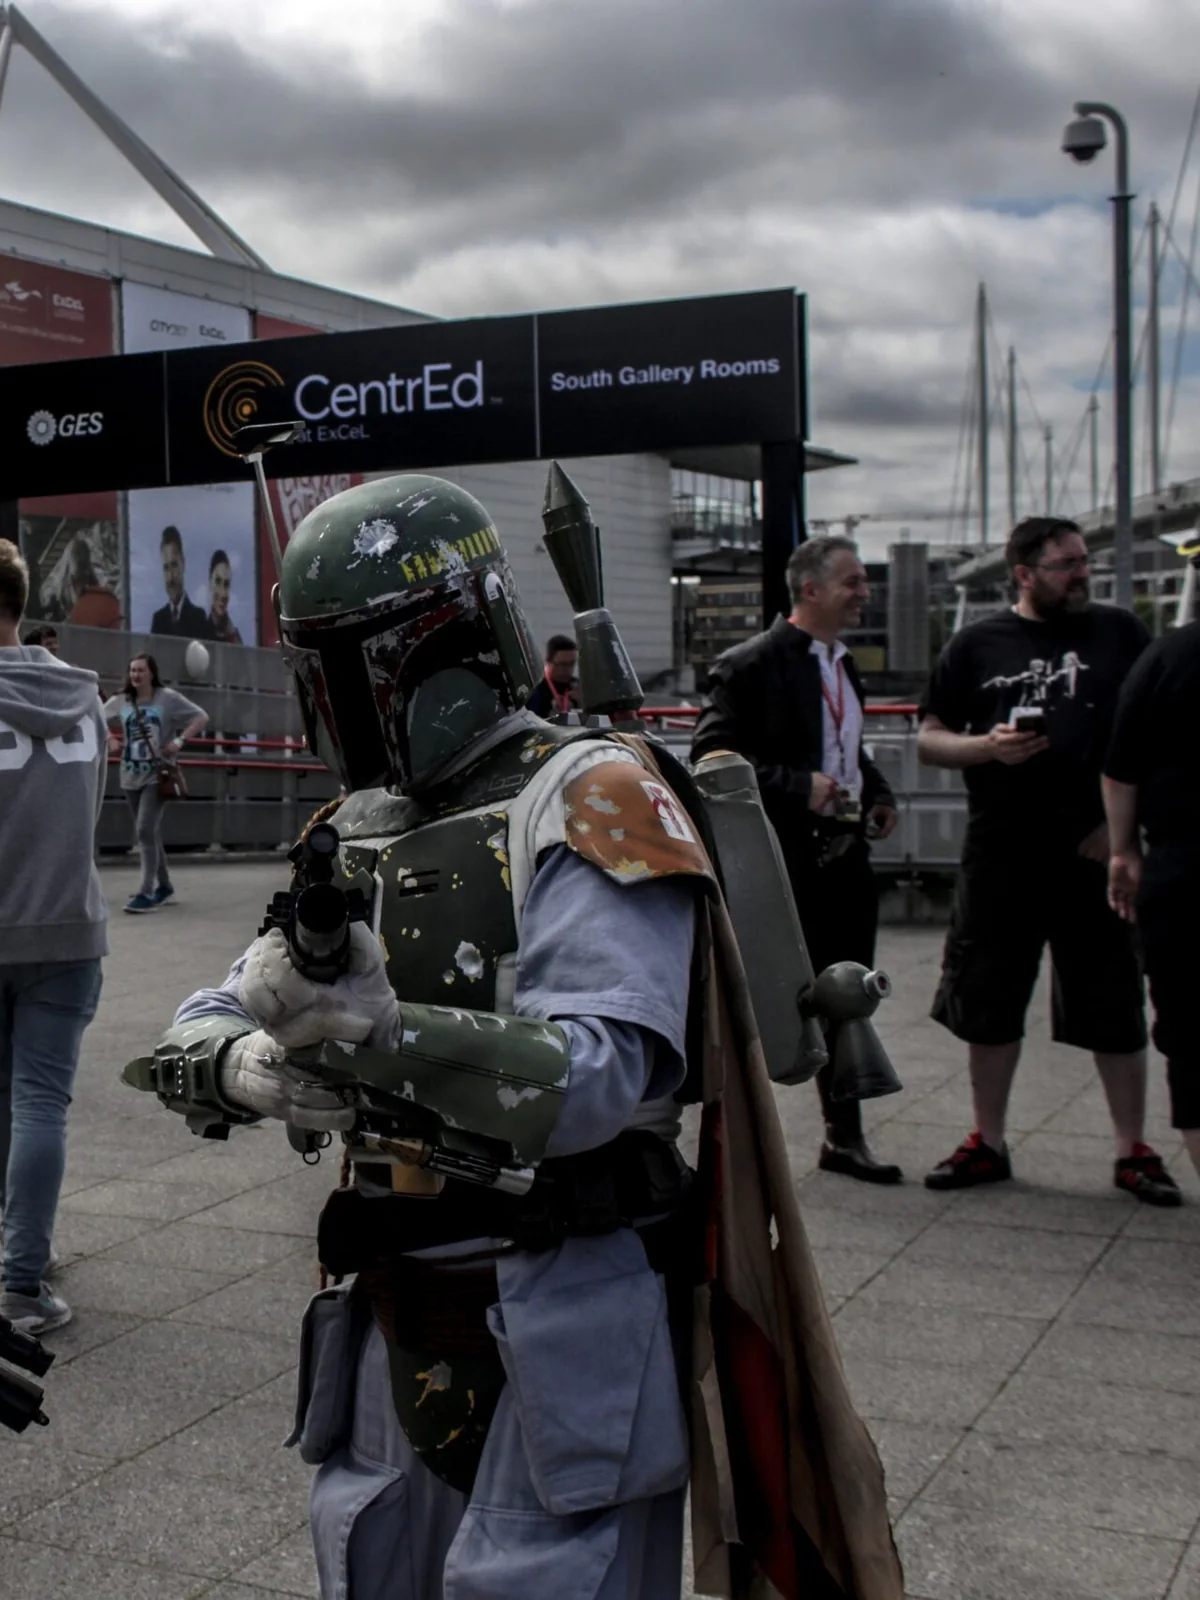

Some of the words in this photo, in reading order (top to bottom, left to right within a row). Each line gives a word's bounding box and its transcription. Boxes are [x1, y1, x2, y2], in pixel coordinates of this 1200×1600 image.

[551, 369, 613, 391] South
[619, 365, 695, 385] Gallery
[700, 358, 781, 379] Rooms
[294, 360, 484, 420] CentrEd
[58, 412, 104, 437] GES
[317, 424, 370, 441] ExCeL
